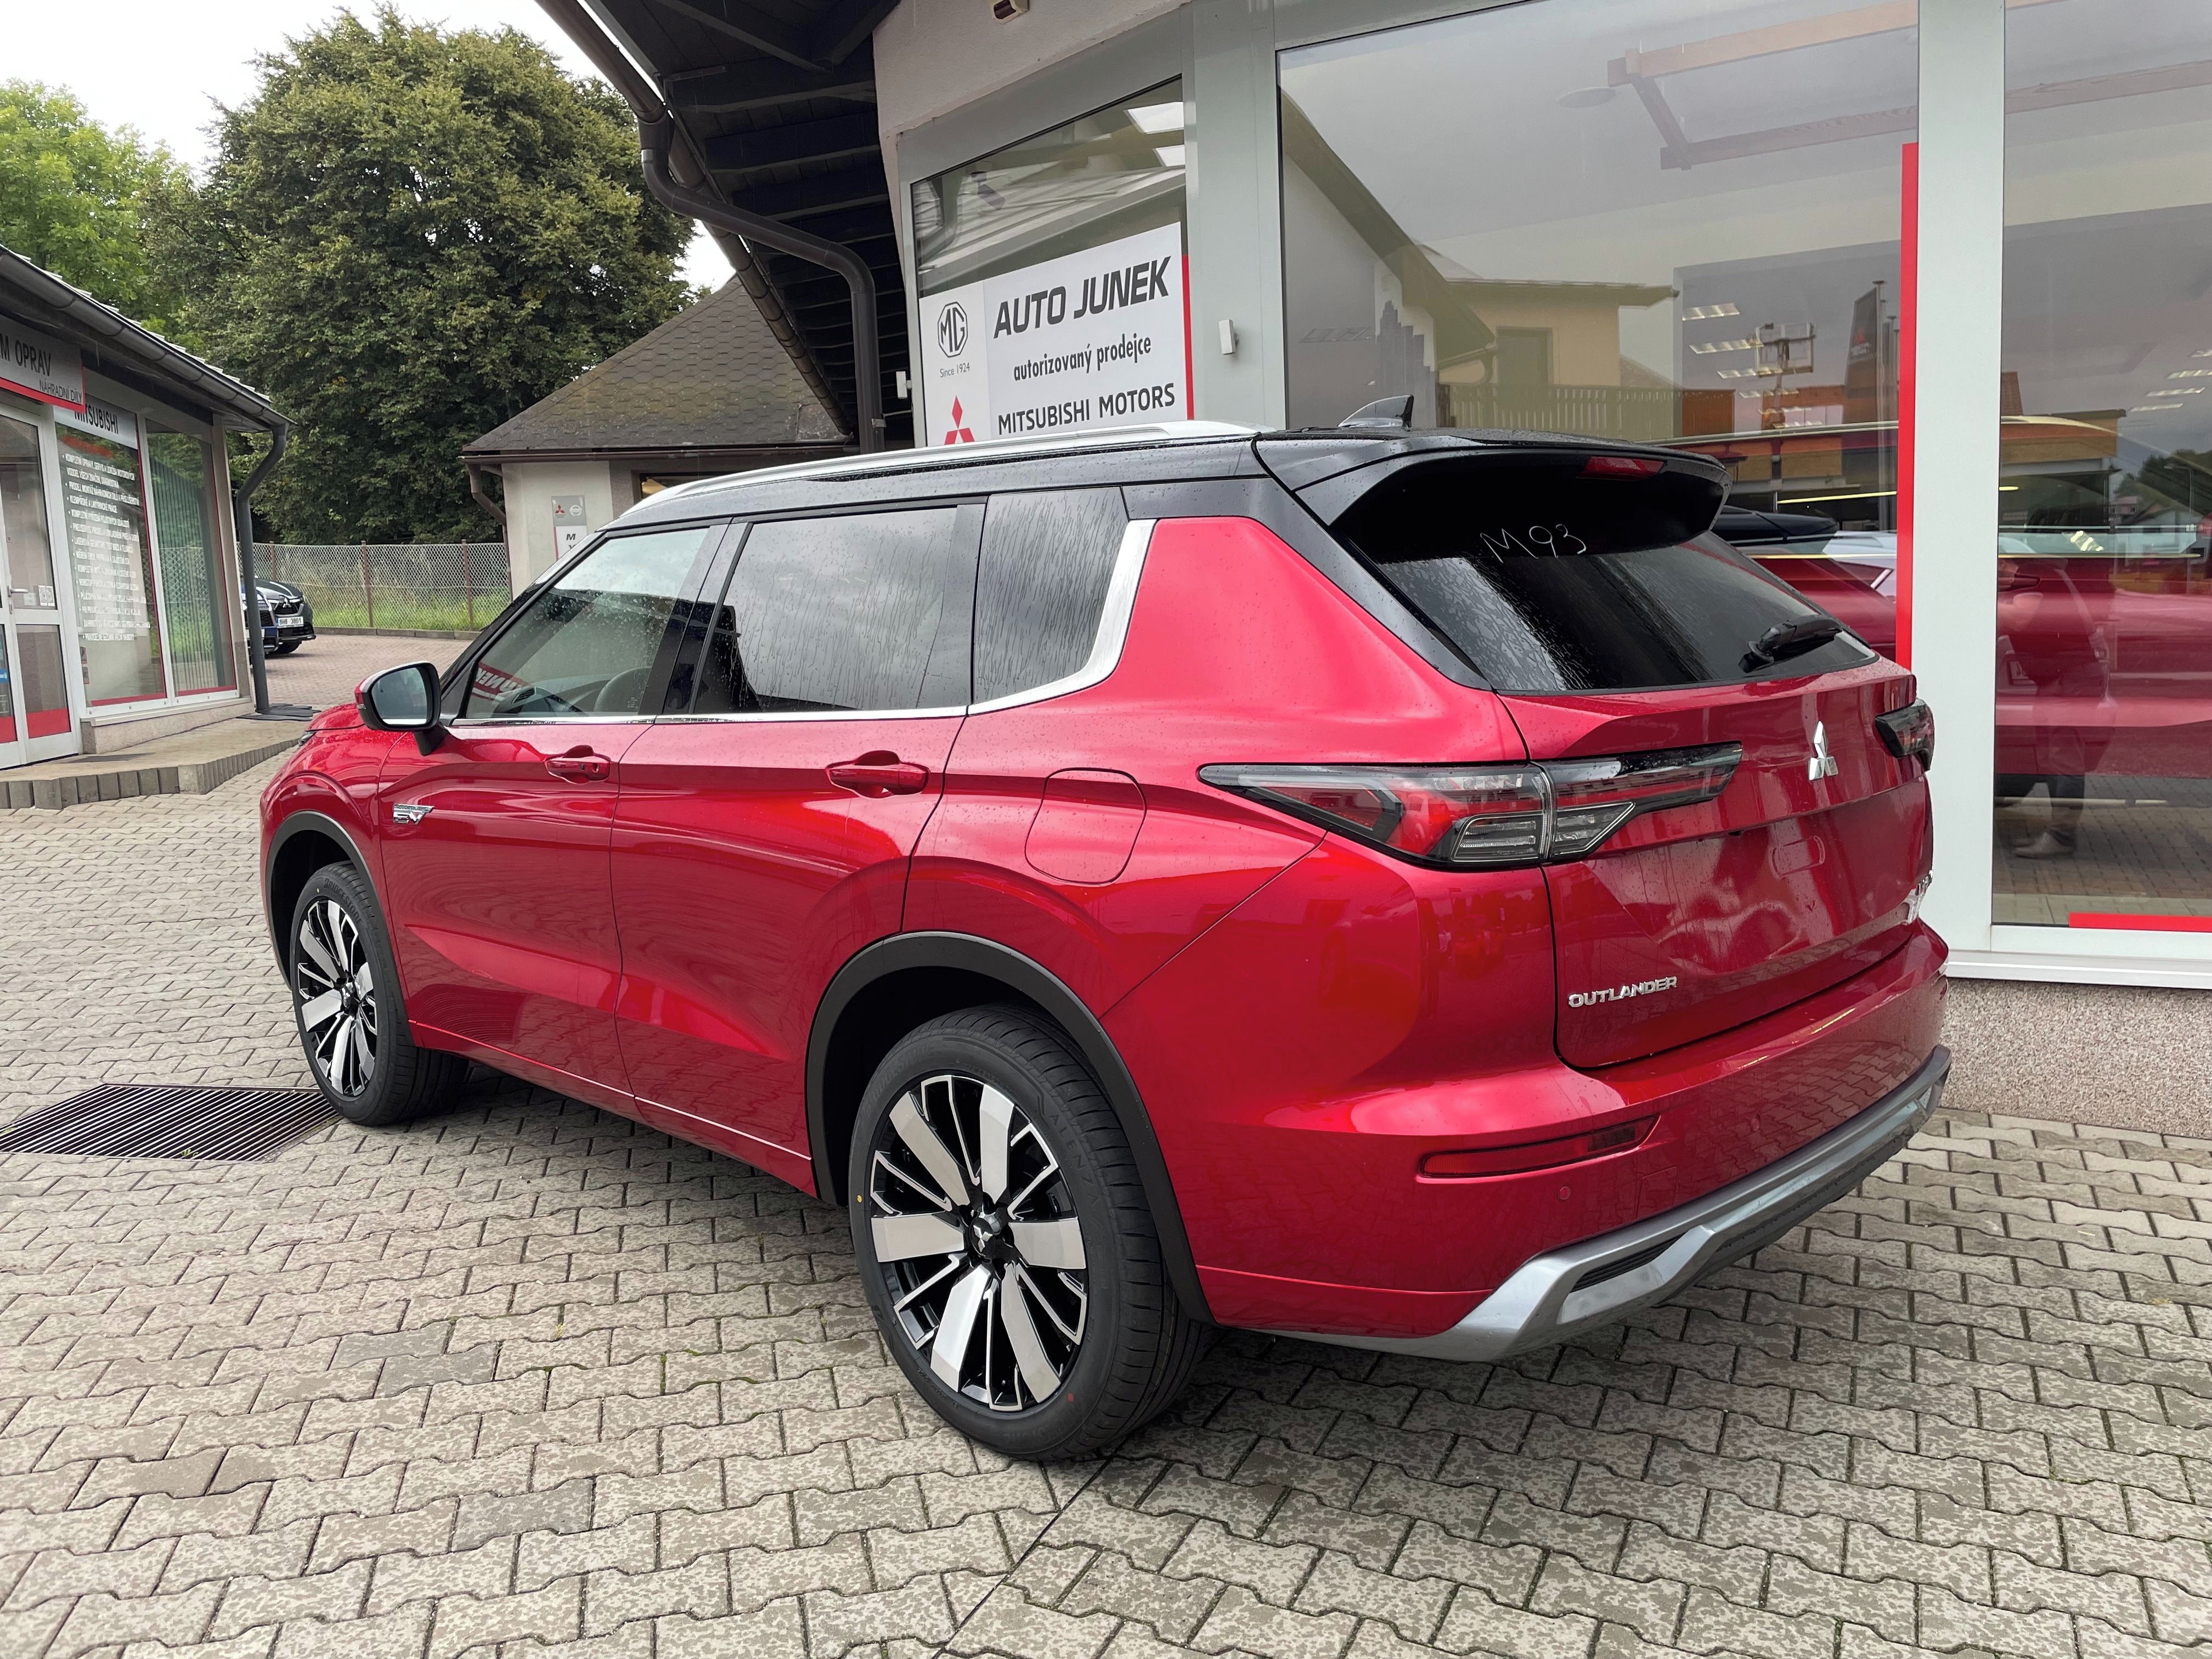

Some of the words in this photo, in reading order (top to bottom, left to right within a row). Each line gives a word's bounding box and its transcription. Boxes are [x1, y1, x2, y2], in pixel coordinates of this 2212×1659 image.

[994, 286, 1066, 339] AUTO
[1074, 256, 1171, 319] JUNEK
[940, 307, 966, 353] MG
[15, 338, 51, 377] OPRAV
[940, 368, 955, 378] Since
[956, 362, 970, 374] 1924
[1014, 343, 1092, 381] autorizovaný
[1097, 333, 1151, 371] prodejce
[998, 398, 1090, 435] MITSUBISHI
[1099, 383, 1175, 417] MOTORS
[1568, 975, 1677, 1008] OUTLANDER
